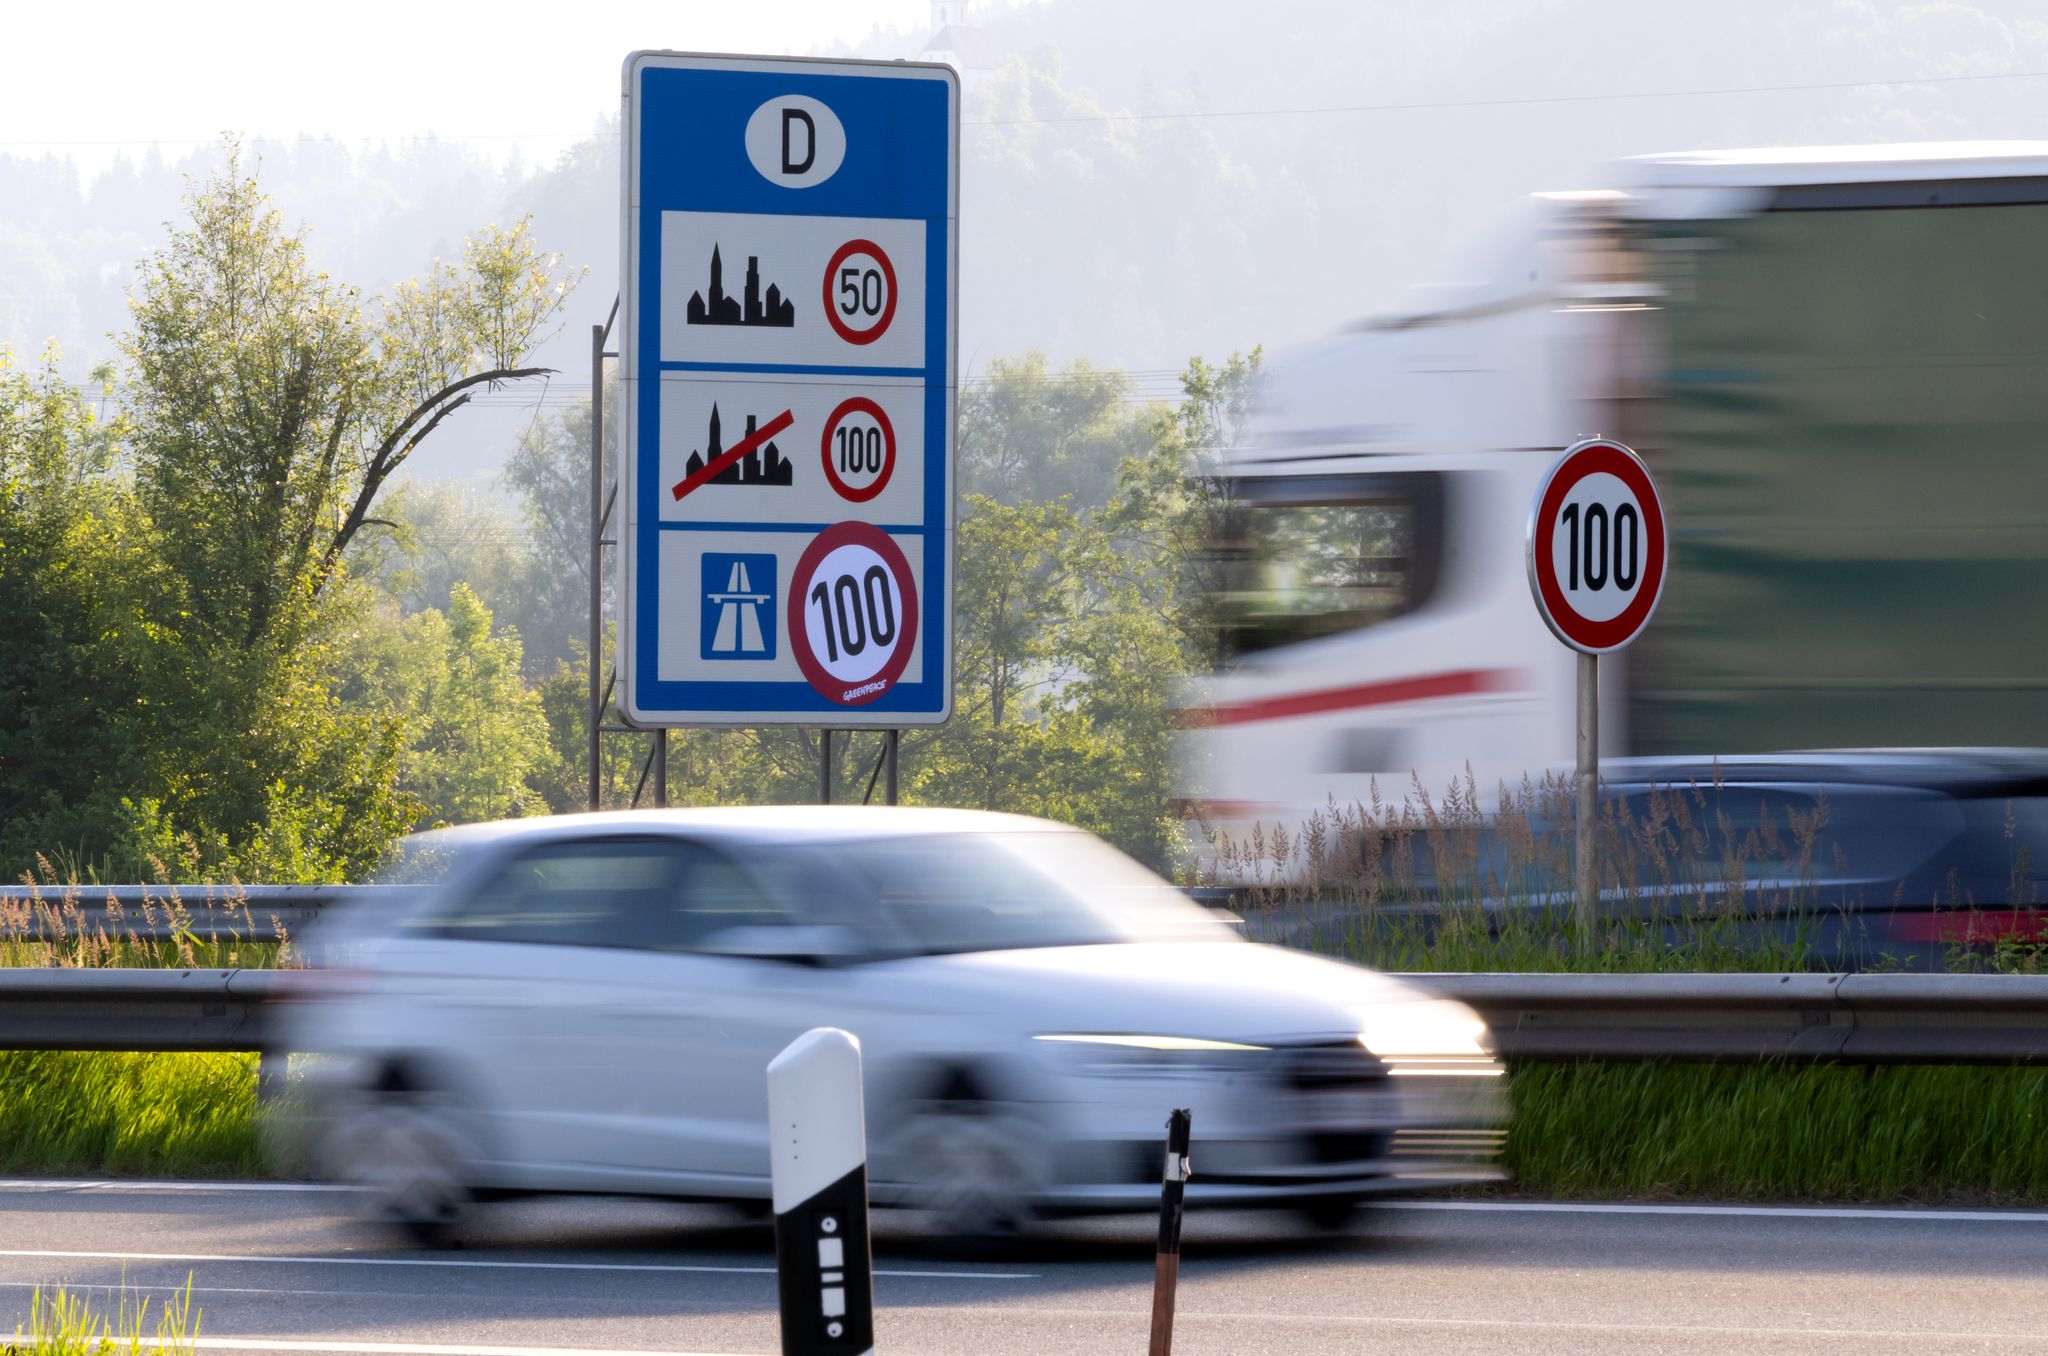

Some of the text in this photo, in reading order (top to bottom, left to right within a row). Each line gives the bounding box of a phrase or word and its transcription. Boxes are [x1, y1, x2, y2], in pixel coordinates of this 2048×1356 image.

[781, 108, 816, 175] D
[840, 268, 882, 317] 50
[836, 426, 881, 474] 100
[1562, 502, 1638, 592] 100
[811, 565, 896, 663] 100
[842, 679, 887, 702] GREENPEACE
